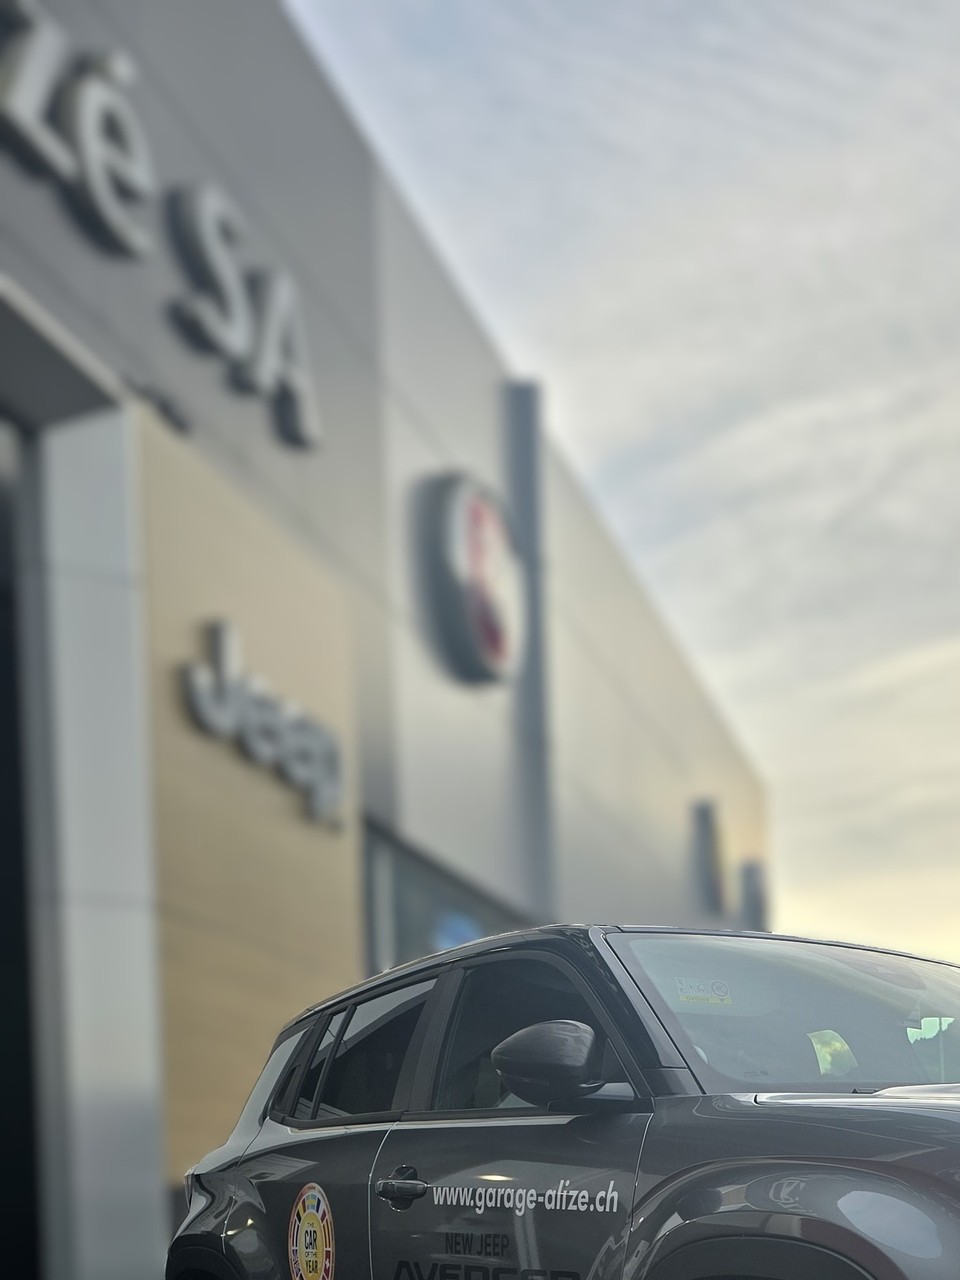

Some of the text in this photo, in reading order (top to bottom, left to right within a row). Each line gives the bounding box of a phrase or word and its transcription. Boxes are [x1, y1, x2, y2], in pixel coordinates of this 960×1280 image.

[175, 183, 322, 446] SA
[178, 618, 346, 832] Jeep
[433, 1180, 618, 1216] www.garage-alize.ch
[305, 1230, 317, 1250] CAR
[445, 1233, 509, 1257] NEW JEEP
[305, 1260, 318, 1274] YEAR
